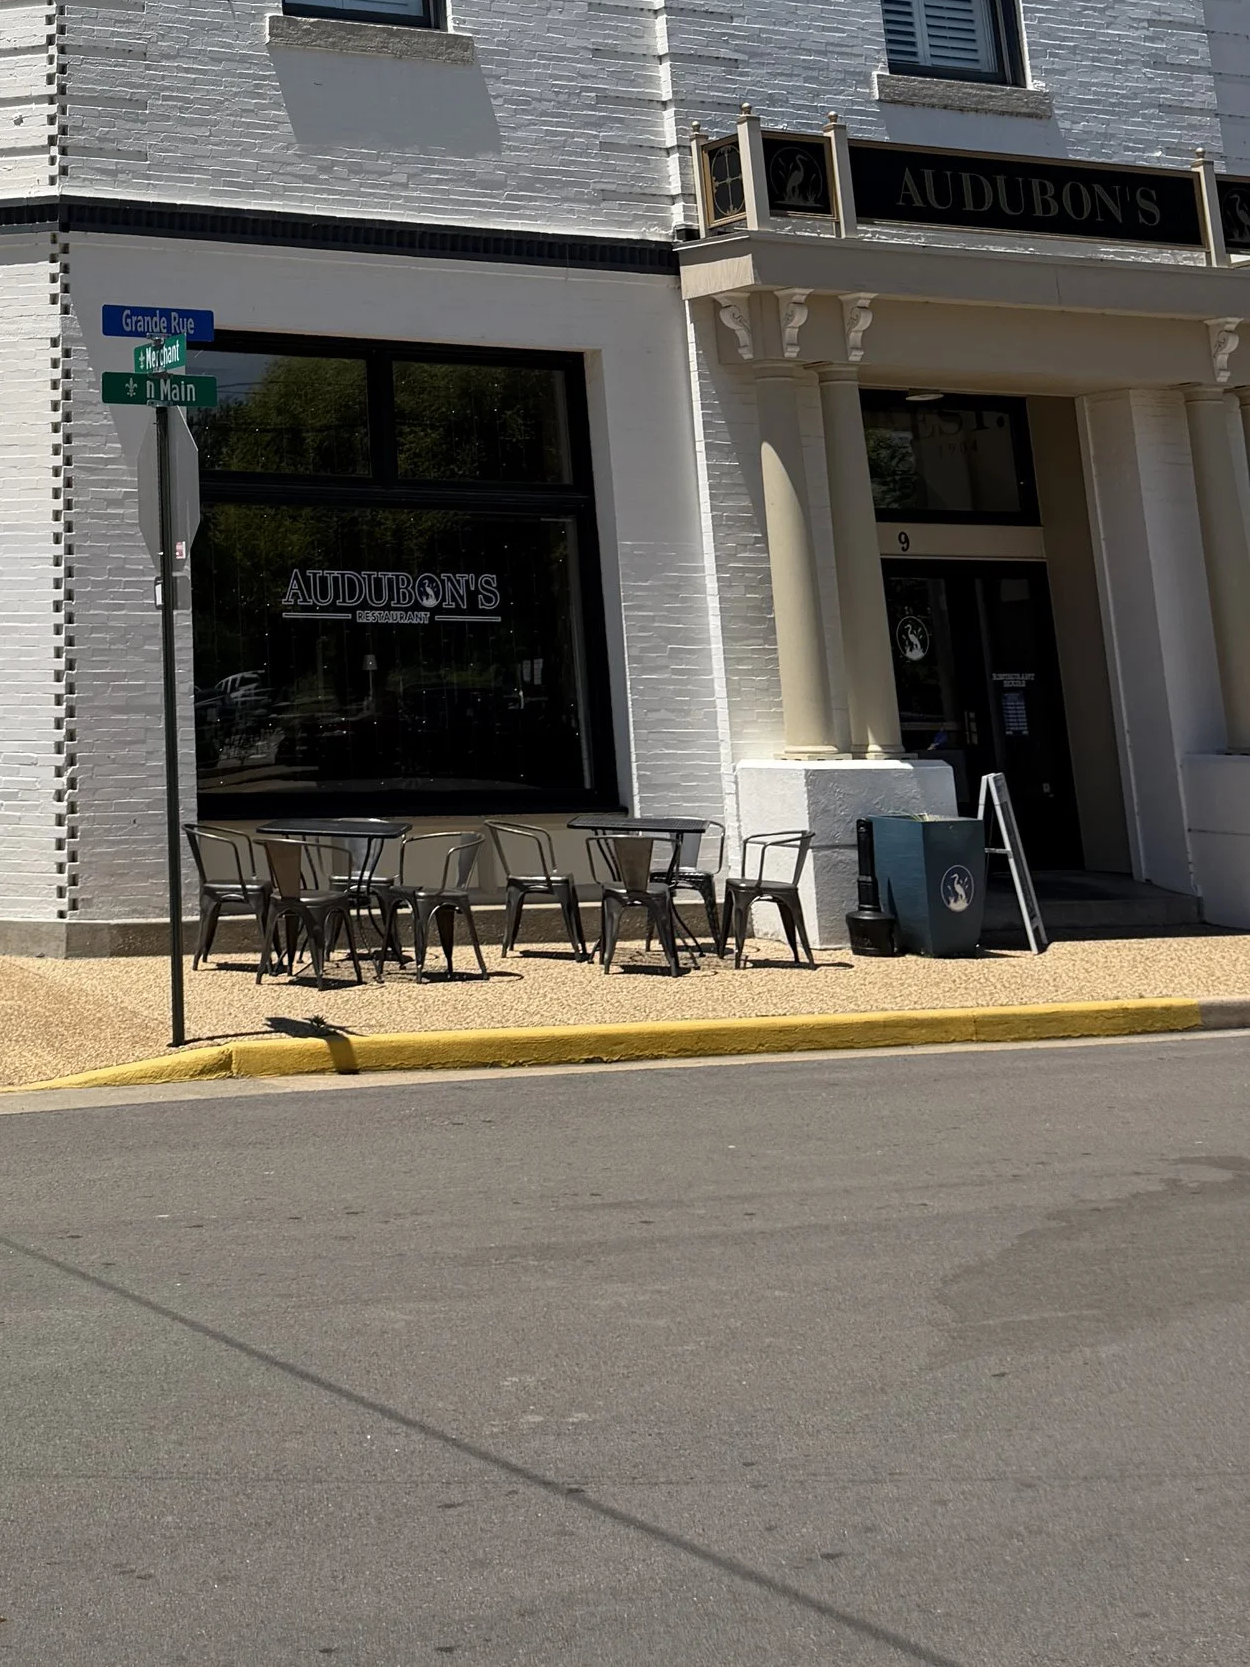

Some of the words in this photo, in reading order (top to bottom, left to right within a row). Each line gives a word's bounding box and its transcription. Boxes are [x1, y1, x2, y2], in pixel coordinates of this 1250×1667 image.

[895, 166, 1161, 227] AUDUBON'S
[122, 309, 167, 333] Grande
[171, 311, 195, 334] Rue
[160, 378, 196, 402] Main
[898, 531, 910, 552] 9
[281, 568, 501, 610] AUDUBON'S
[356, 610, 430, 624] RESTAURANT
